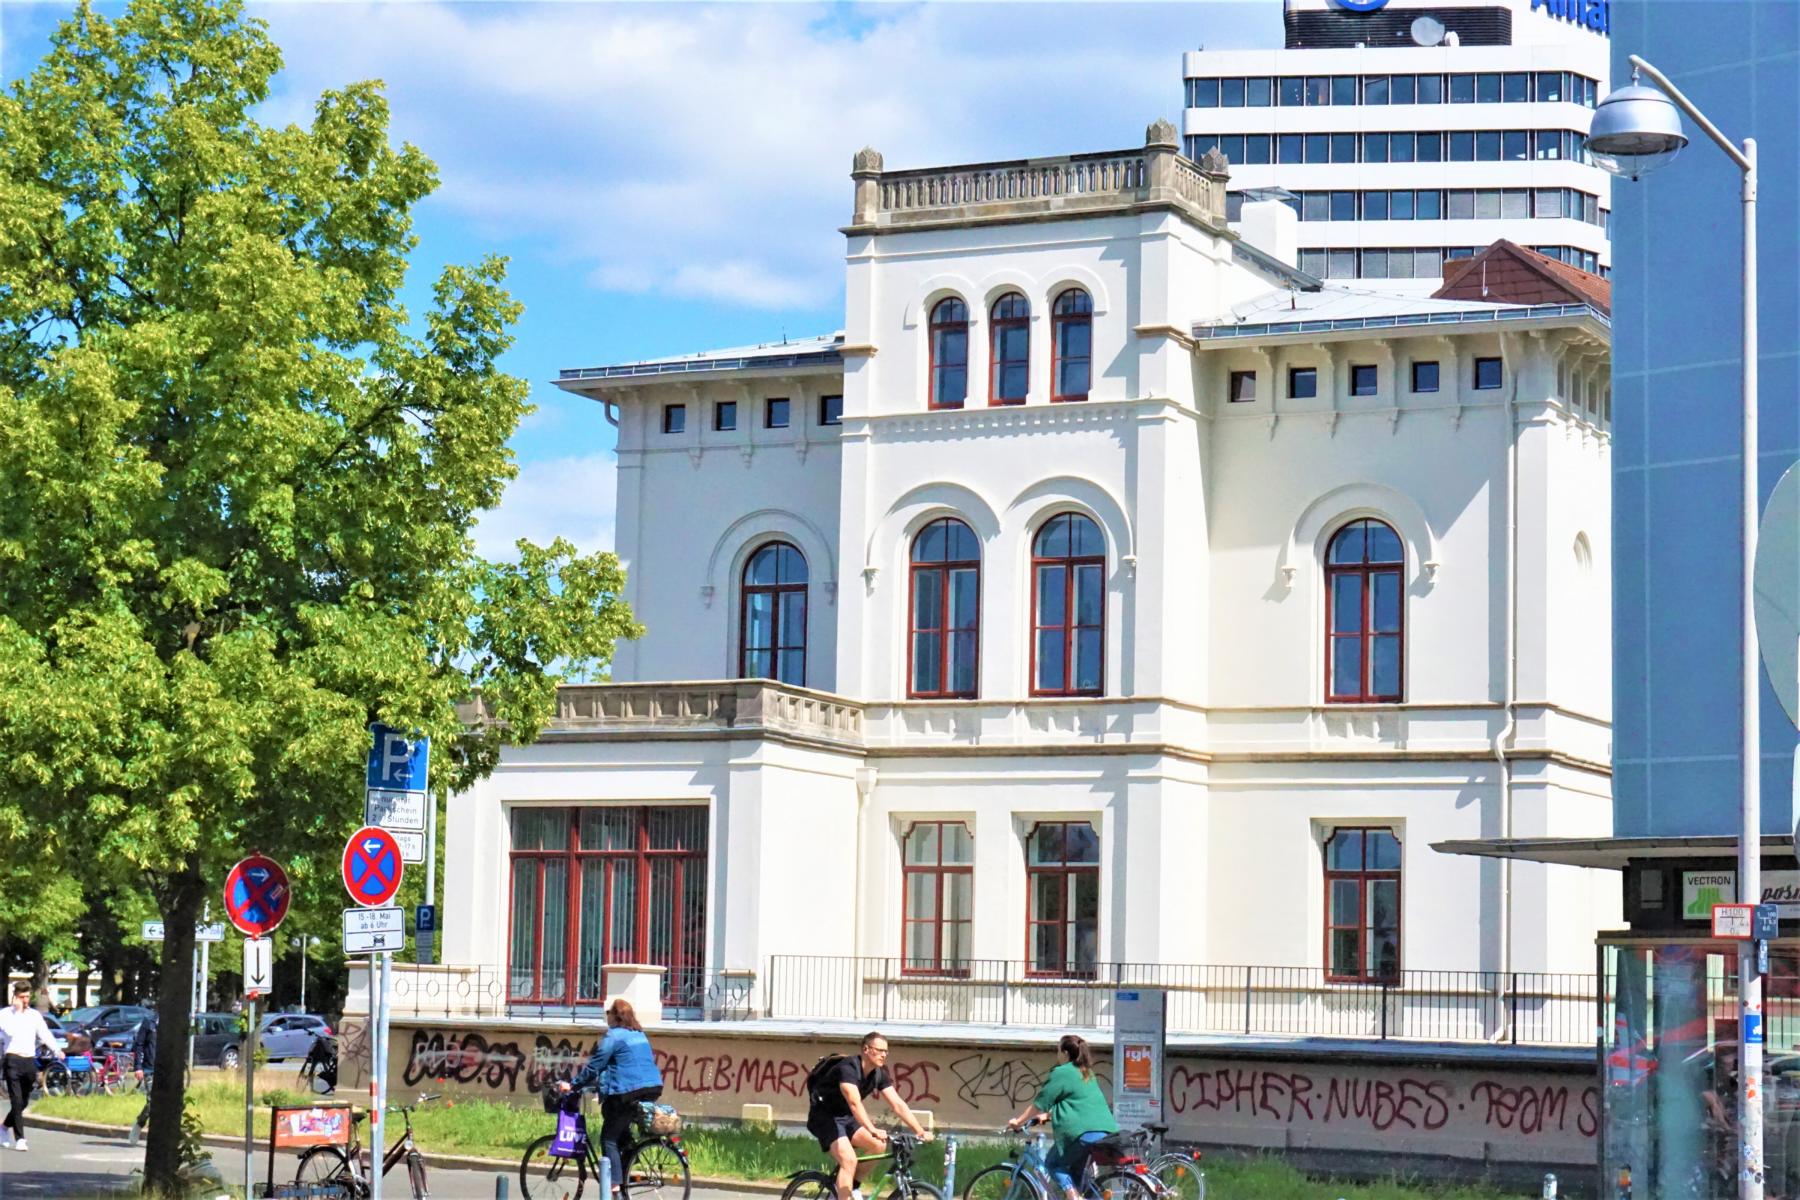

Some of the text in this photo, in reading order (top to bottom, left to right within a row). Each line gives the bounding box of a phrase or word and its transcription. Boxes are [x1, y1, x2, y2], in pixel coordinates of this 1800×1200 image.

[382, 732, 415, 781] P
[387, 814, 419, 825] Stunden
[1687, 876, 1731, 886] VECTRON
[379, 911, 391, 920] Mai
[360, 921, 369, 929] ab
[376, 920, 388, 928] Uhr
